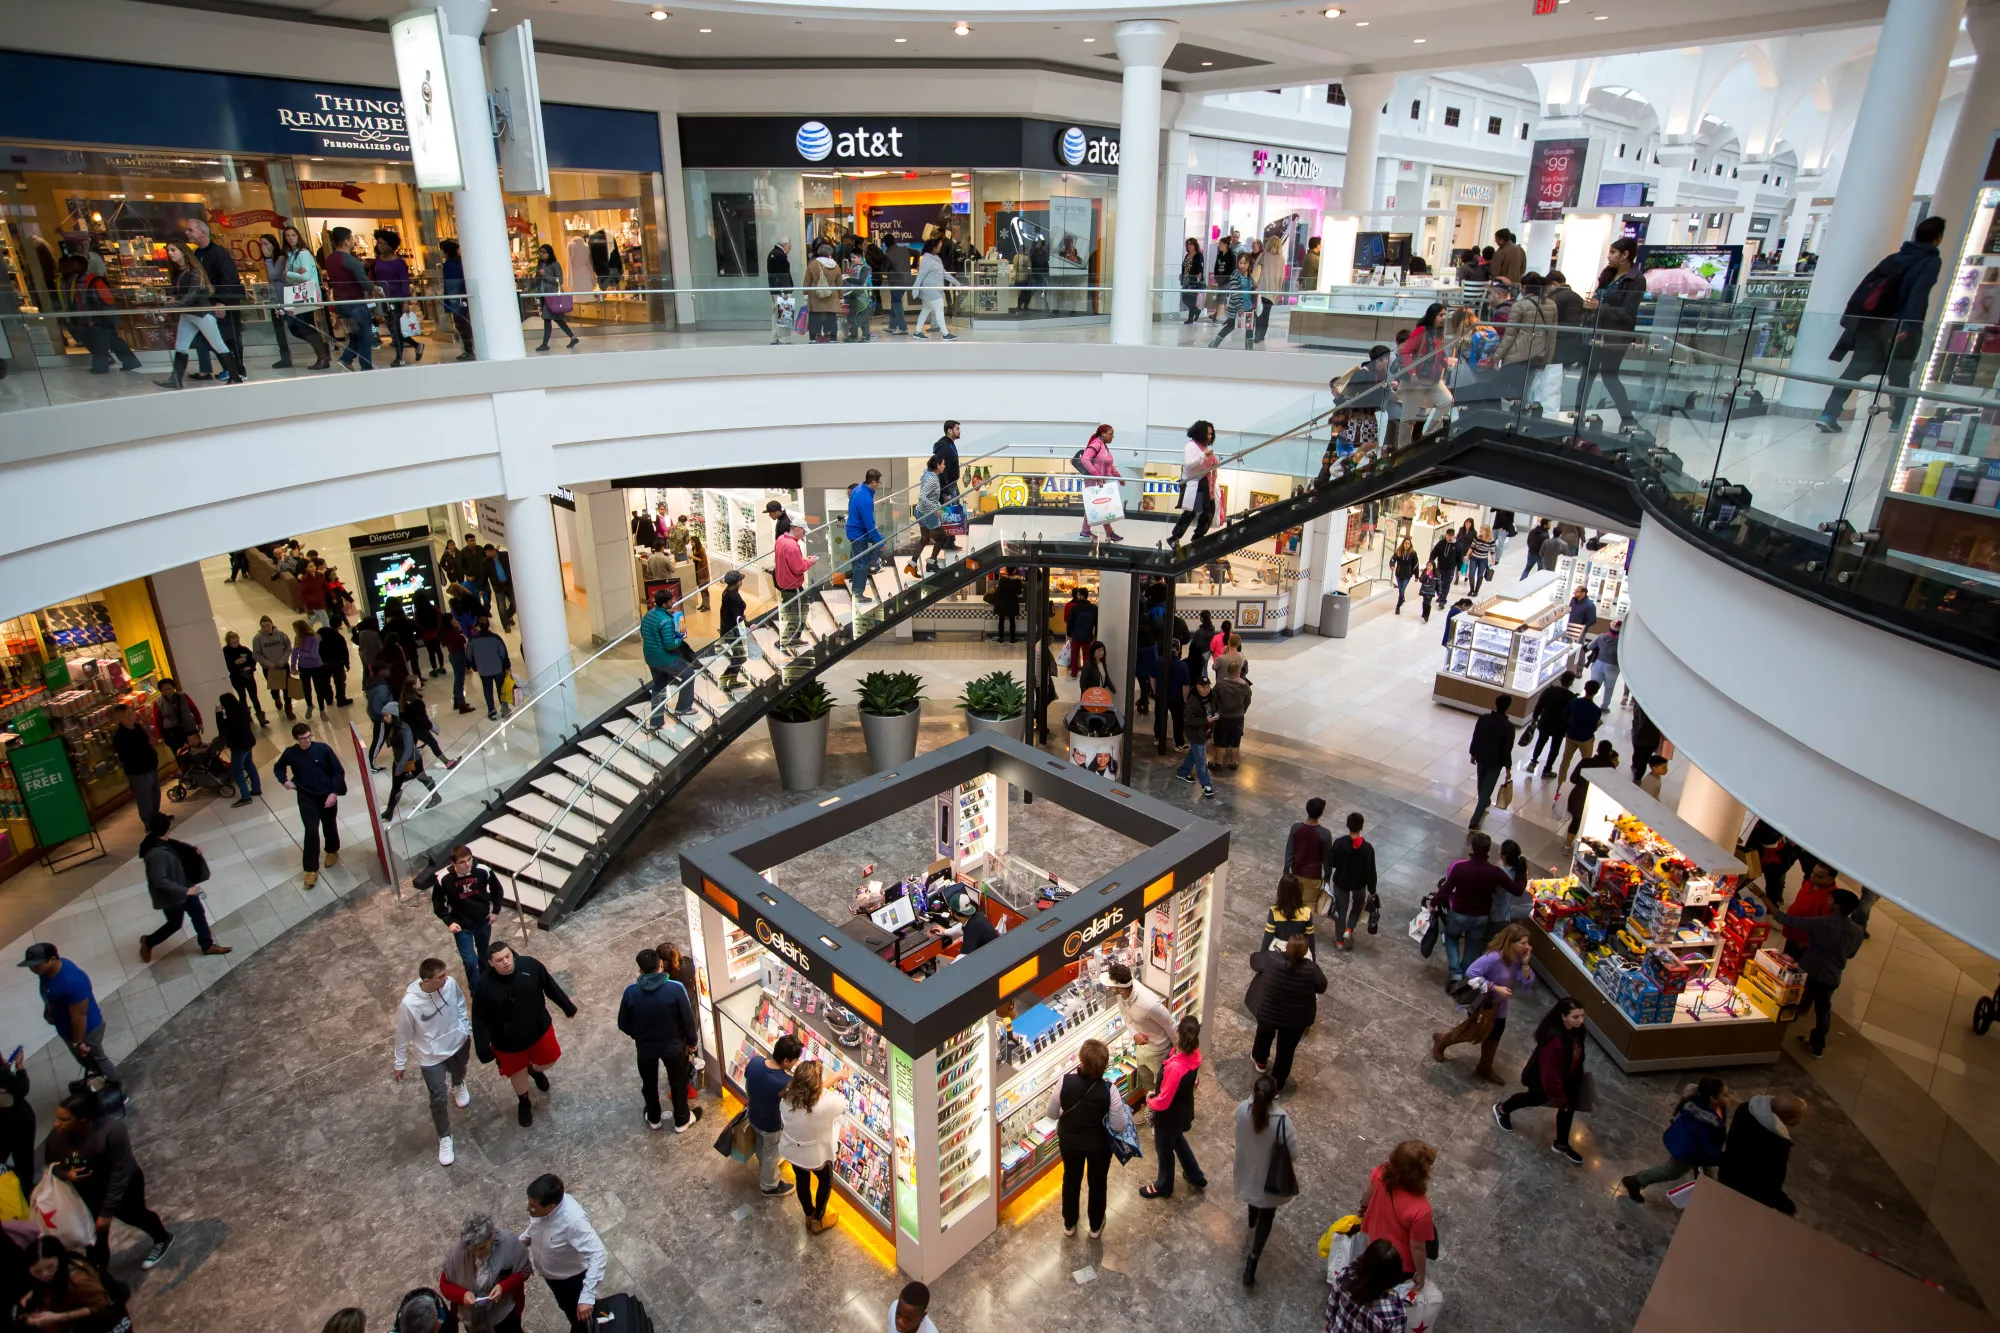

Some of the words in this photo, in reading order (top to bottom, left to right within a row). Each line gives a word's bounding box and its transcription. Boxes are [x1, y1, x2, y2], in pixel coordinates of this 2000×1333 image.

[277, 108, 408, 132] REMEMBE
[323, 138, 392, 151] PERSONALIZED
[393, 143, 411, 152] GIF
[836, 126, 903, 158] at&t
[1087, 135, 1121, 165] at&
[369, 530, 411, 544] Directory
[24, 772, 63, 793] FREE!
[462, 882, 473, 893] K
[1063, 906, 1124, 957] Cellairis
[755, 917, 810, 971] Cellairis
